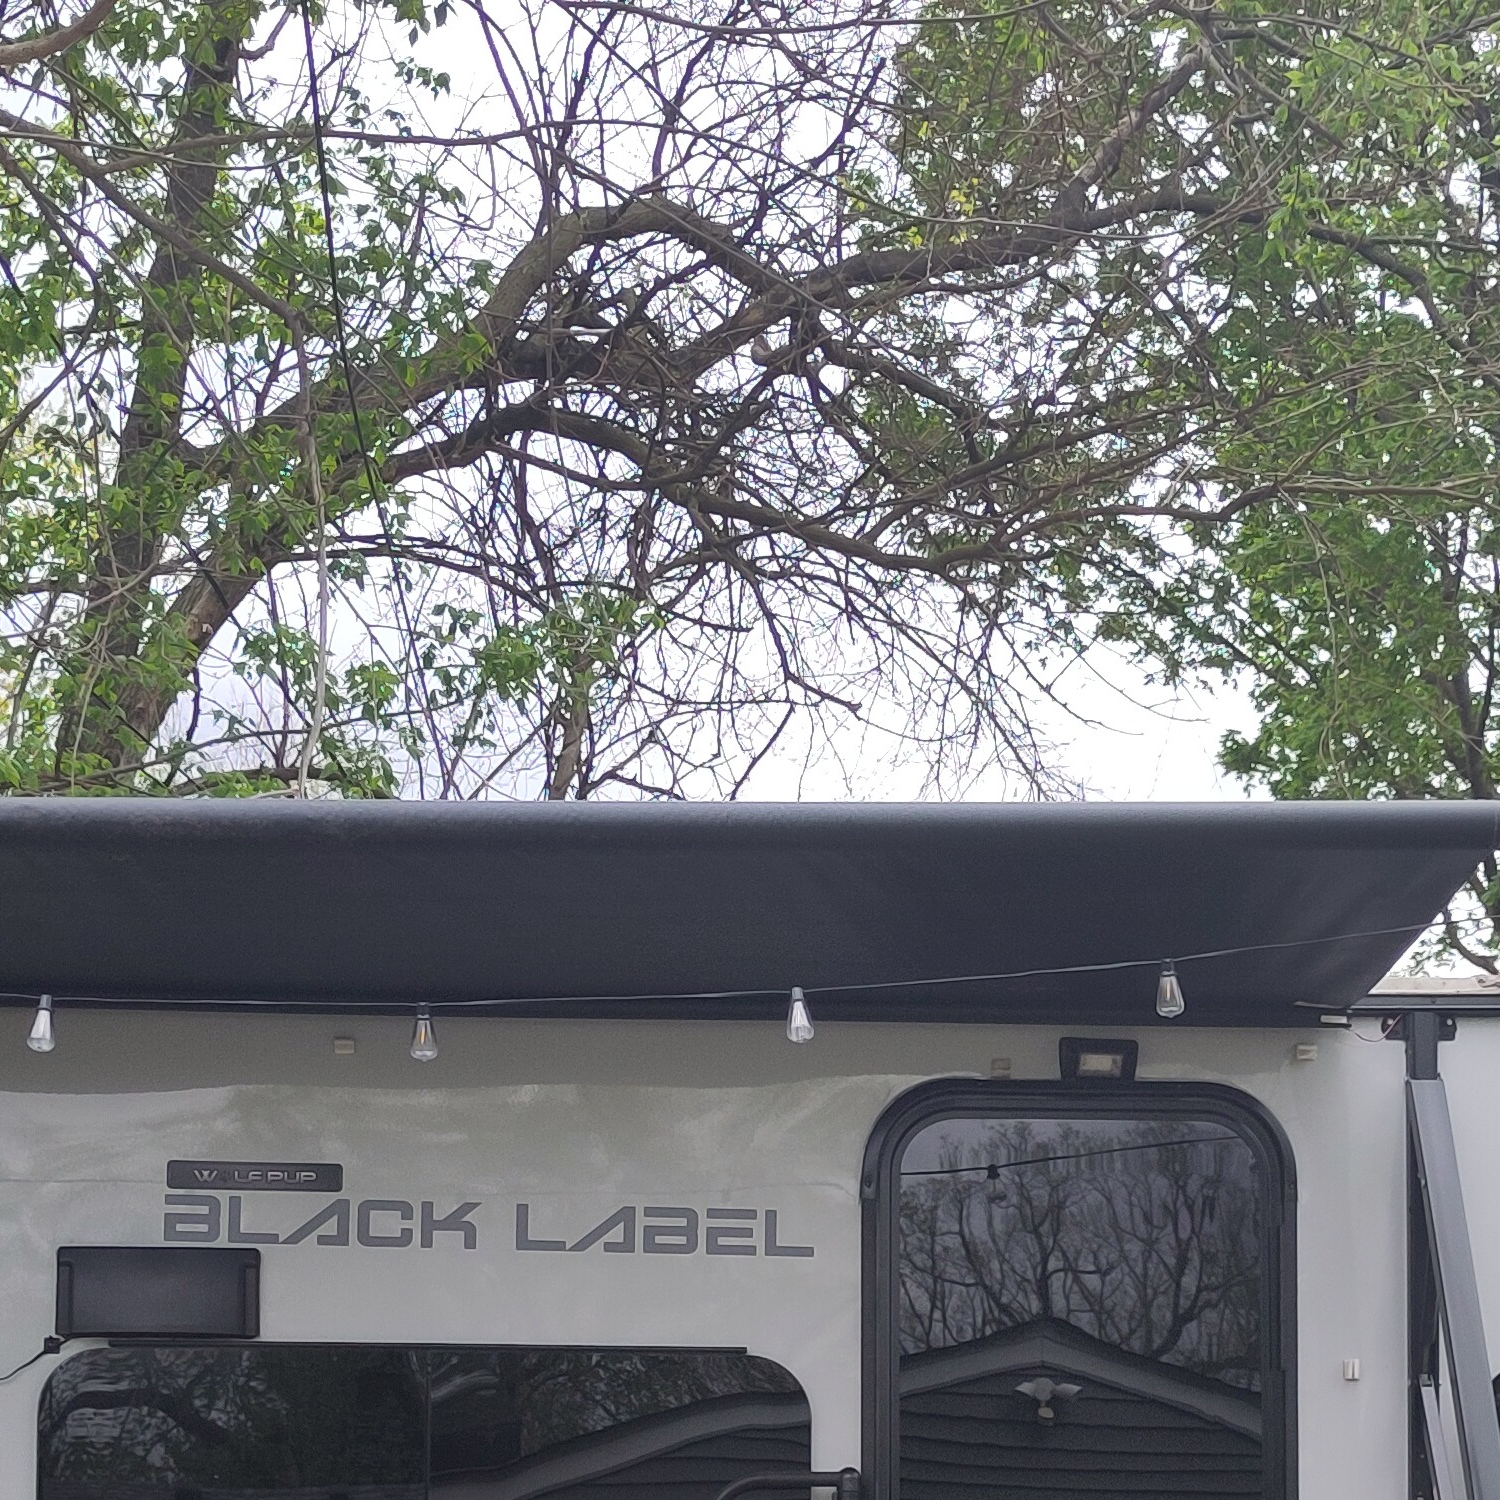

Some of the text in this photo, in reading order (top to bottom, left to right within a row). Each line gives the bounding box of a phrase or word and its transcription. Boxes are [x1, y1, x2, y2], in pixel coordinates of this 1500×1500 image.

[193, 1169, 317, 1184] WLF PUP
[163, 1194, 814, 1258] BLACK LABEL
